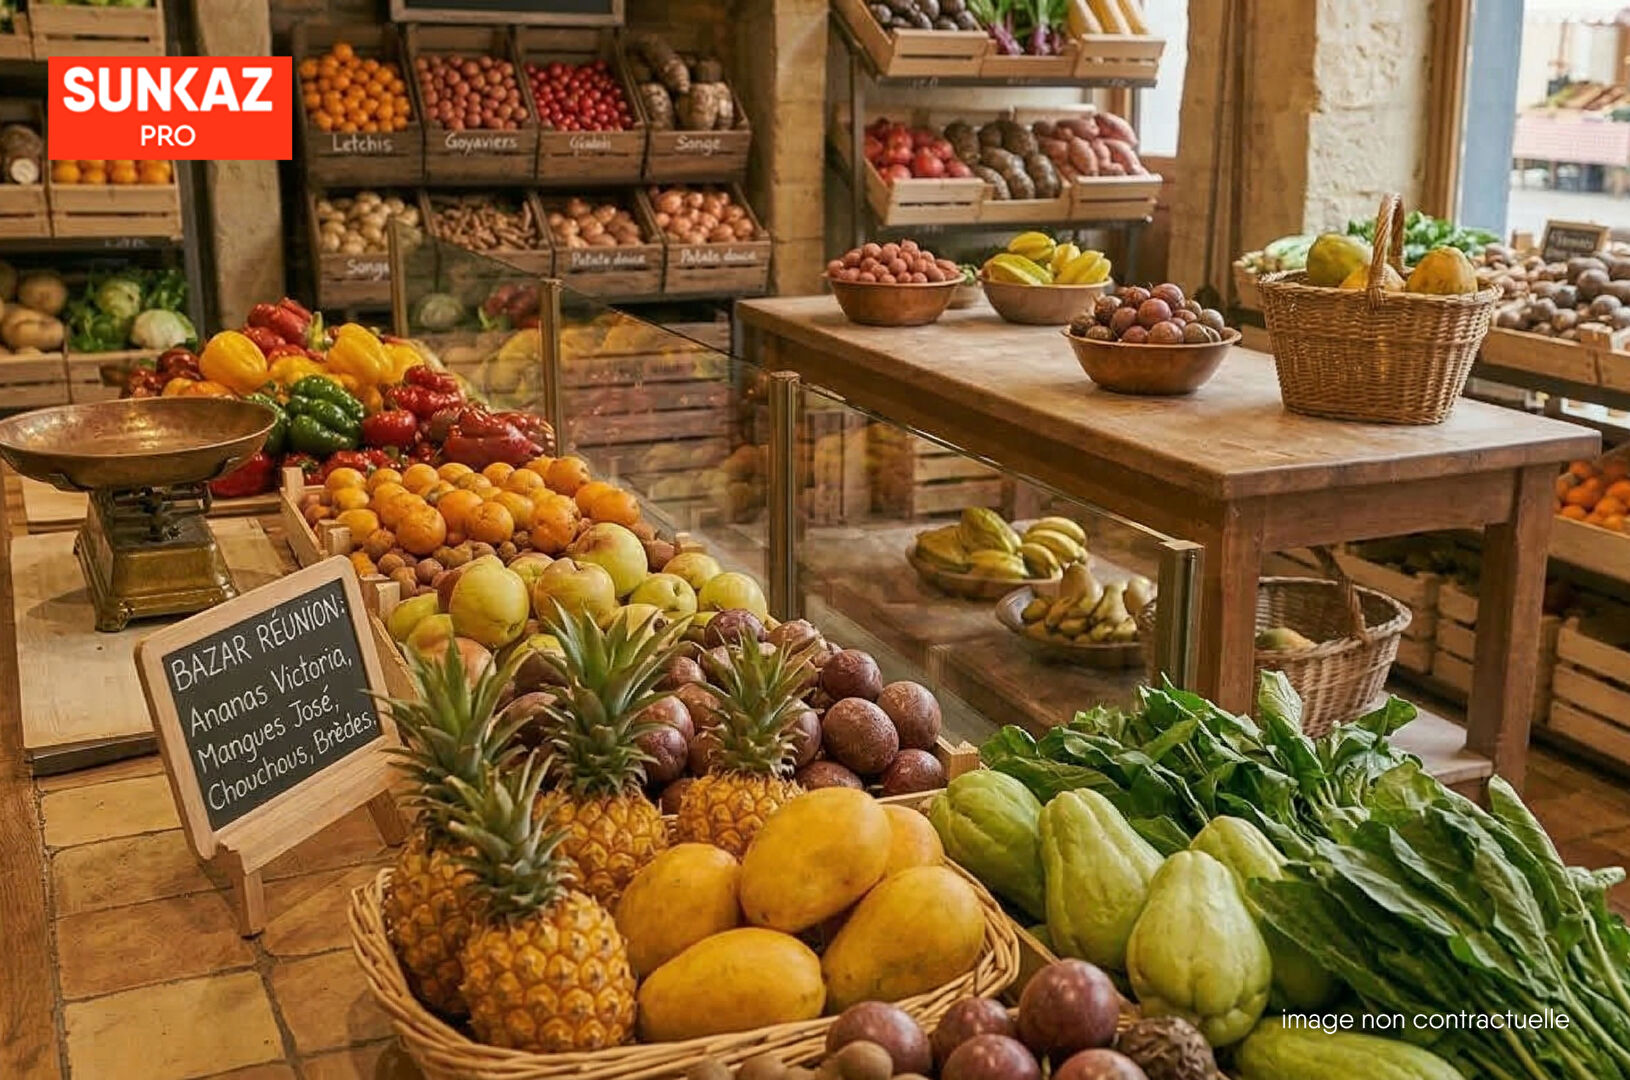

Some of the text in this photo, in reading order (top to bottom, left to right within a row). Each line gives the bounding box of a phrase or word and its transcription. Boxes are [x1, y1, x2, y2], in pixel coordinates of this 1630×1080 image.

[332, 134, 393, 153] Letchis
[445, 133, 517, 157] Goyaviers
[675, 135, 721, 157] Songe
[171, 593, 346, 692] BAZAR RÉUNION:
[191, 647, 352, 737] Ananas Victoria,
[197, 685, 340, 774] Mangues José,
[208, 711, 377, 810] Chouchous, Brèdes.
